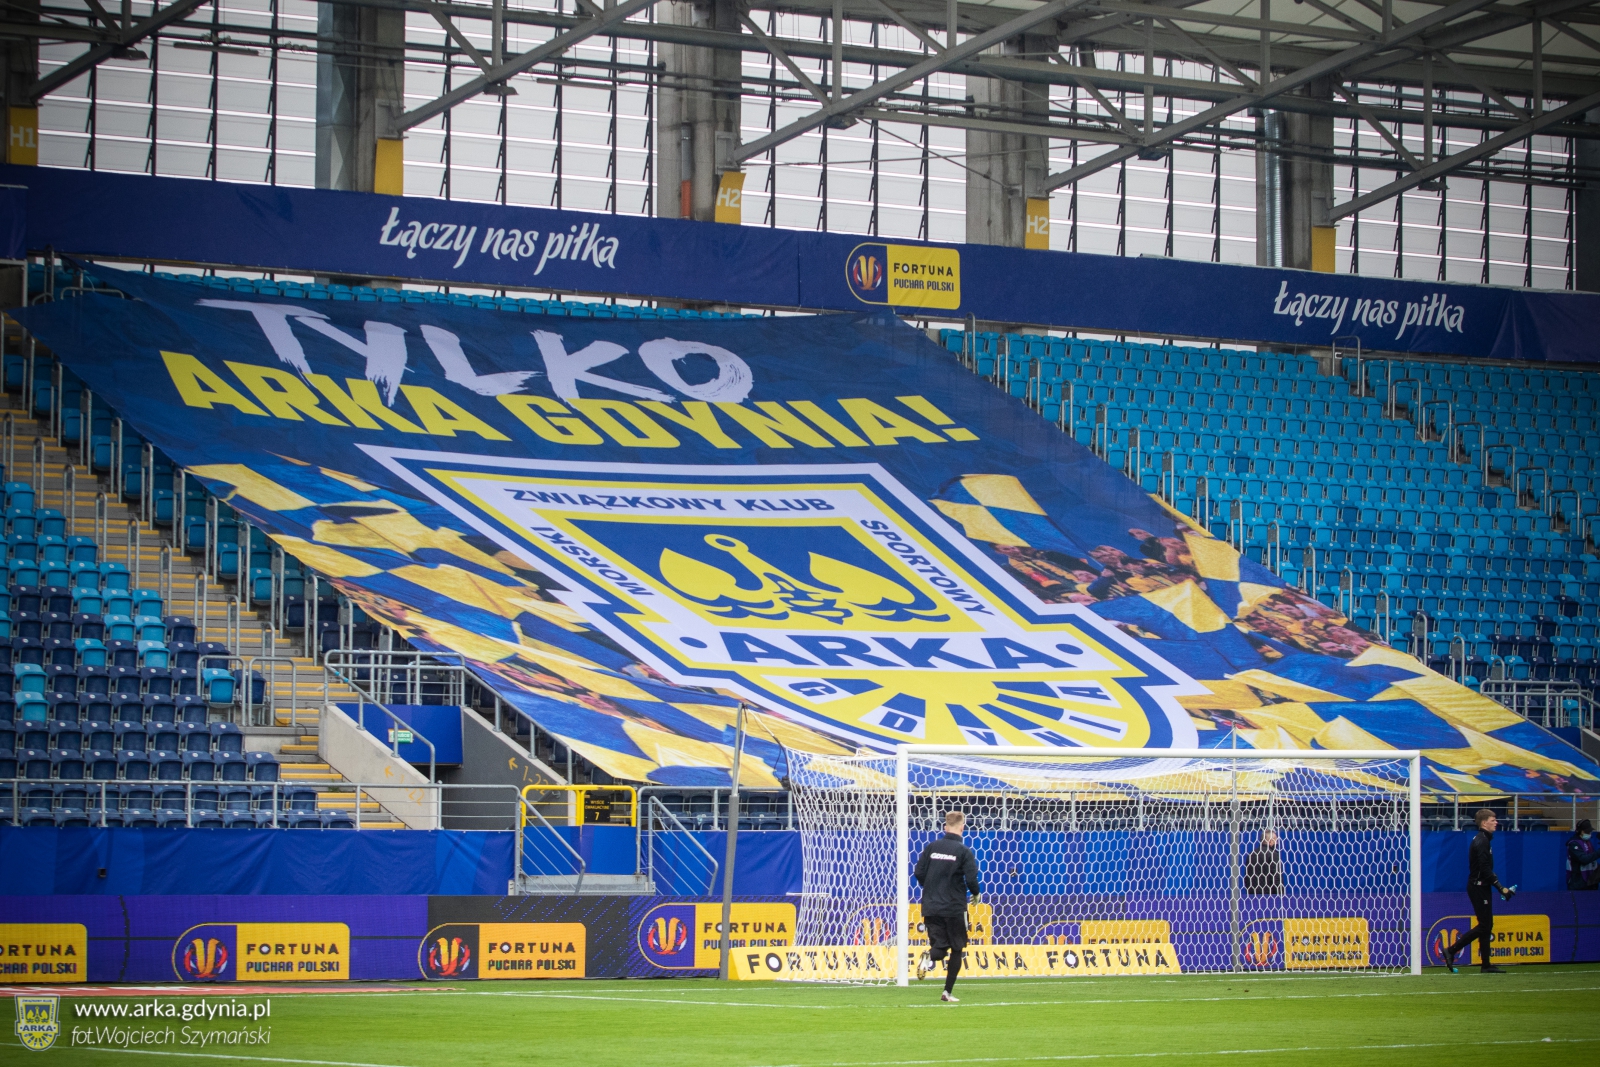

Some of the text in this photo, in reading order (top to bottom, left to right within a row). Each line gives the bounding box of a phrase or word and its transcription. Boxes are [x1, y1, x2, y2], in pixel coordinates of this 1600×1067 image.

[9, 126, 37, 148] H1
[716, 187, 741, 208] H2
[1026, 214, 1049, 235] H2
[379, 206, 620, 276] Łączy nas piłka
[893, 261, 954, 278] FORTUNA
[893, 278, 955, 293] PUCHAR POLSKI
[1273, 280, 1465, 341] Łączy nas piłka
[195, 299, 754, 407] TYLKO
[160, 349, 981, 450] ARKA GDYNIA!
[503, 487, 837, 513] ZWIĄZKOWY KLUB
[530, 525, 656, 598] MORSKI
[859, 518, 995, 618] SPORTOWY
[719, 632, 1080, 671] ARKA
[594, 811, 600, 821] 7
[703, 922, 787, 933] FORTUNA
[1489, 931, 1544, 942] ORTUNA
[246, 942, 340, 956] FORTUNA
[488, 941, 576, 955] FORTUNA
[1291, 935, 1361, 946] FORTUNA
[1046, 949, 1170, 969] FORTUNA
[1489, 946, 1544, 957] CHAR POLSKI
[32, 962, 77, 975] POLSKI
[246, 960, 340, 974] PUCHAR POLSKI
[488, 958, 576, 972] PUCHAR POLSKI
[747, 951, 882, 974] FORTUNA
